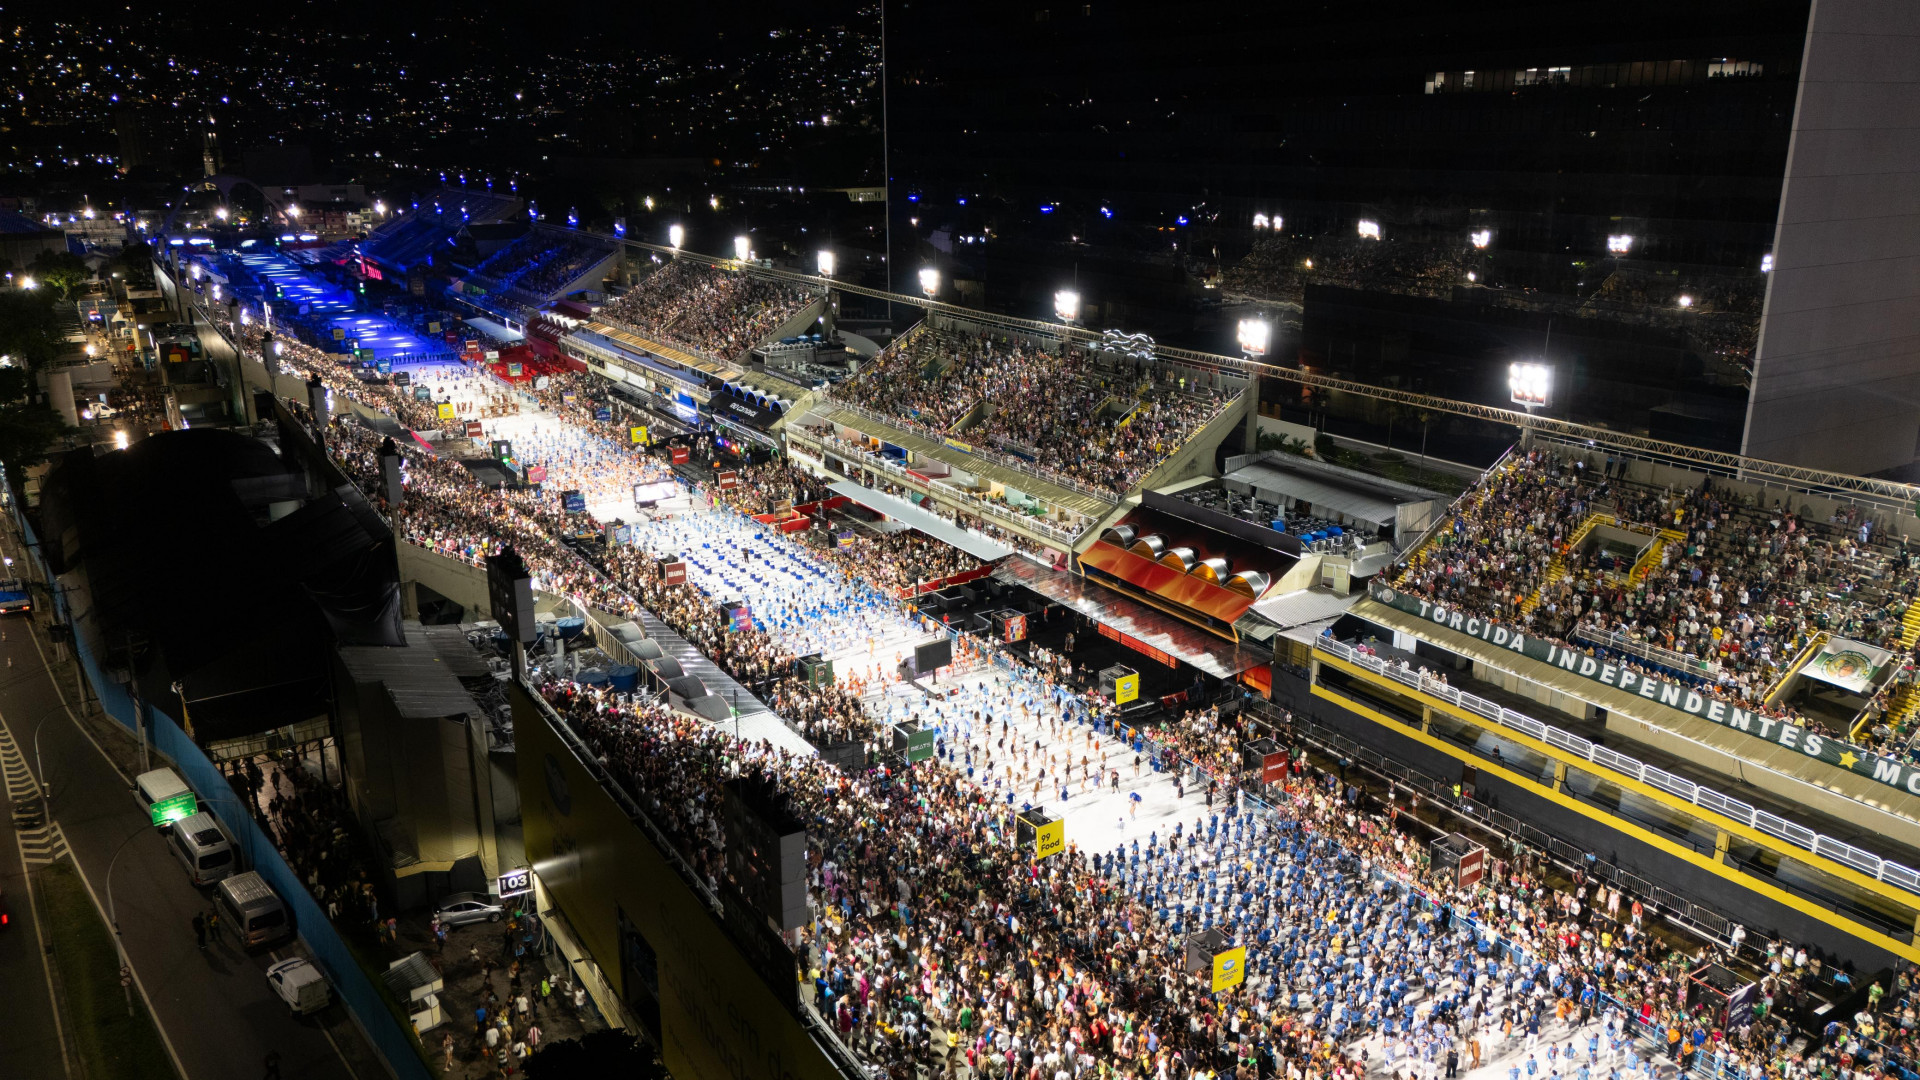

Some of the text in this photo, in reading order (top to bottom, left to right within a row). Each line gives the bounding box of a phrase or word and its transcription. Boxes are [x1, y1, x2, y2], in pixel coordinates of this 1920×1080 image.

[1419, 600, 1524, 652] TORCIDA
[1546, 649, 1824, 756] INDEPENDENTES
[910, 742, 932, 752] BEATS
[1041, 833, 1050, 843] 99
[1041, 838, 1060, 852] Food
[501, 874, 528, 890] 103
